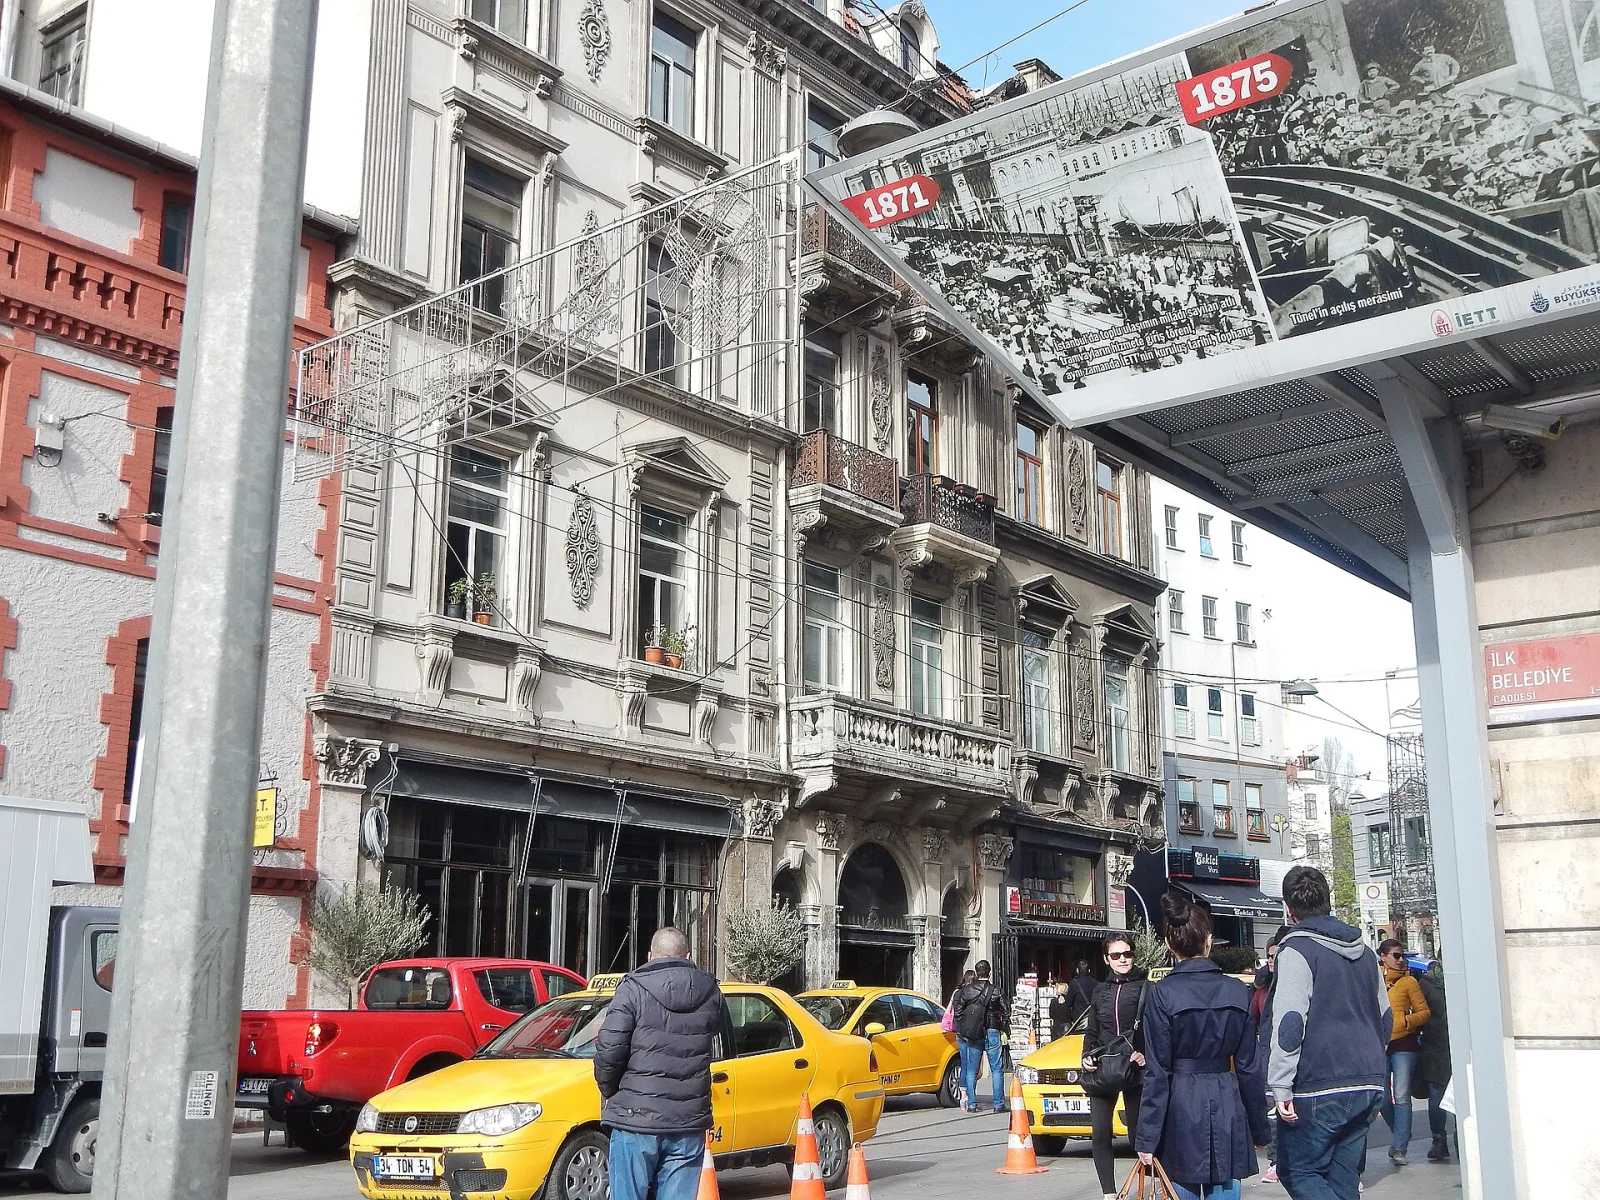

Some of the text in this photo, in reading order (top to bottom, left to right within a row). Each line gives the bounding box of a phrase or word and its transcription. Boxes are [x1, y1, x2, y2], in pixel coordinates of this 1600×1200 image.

[1191, 60, 1278, 114] 1875
[863, 181, 929, 223] 1871
[1100, 326, 1123, 341] toplu
[1122, 318, 1159, 335] ulaşımın
[1187, 302, 1219, 318] sayılan
[1220, 296, 1236, 309] atlı
[1289, 287, 1404, 325] Tünel'in açılış merasimi
[1060, 346, 1111, 365] tramvayların
[1111, 337, 1145, 352] hizmete
[1145, 329, 1165, 348] giriş
[1066, 369, 1084, 381] aynı
[1084, 358, 1120, 375] zamanda
[1154, 342, 1187, 357] kuruluş
[1215, 326, 1254, 344] Tophane
[1491, 649, 1516, 667] İLK
[1492, 666, 1573, 690] BELEDİYE
[1493, 690, 1536, 704] CADDESİ
[1049, 1101, 1059, 1111] 34
[380, 1159, 391, 1172] 34
[419, 1160, 430, 1173] 54
